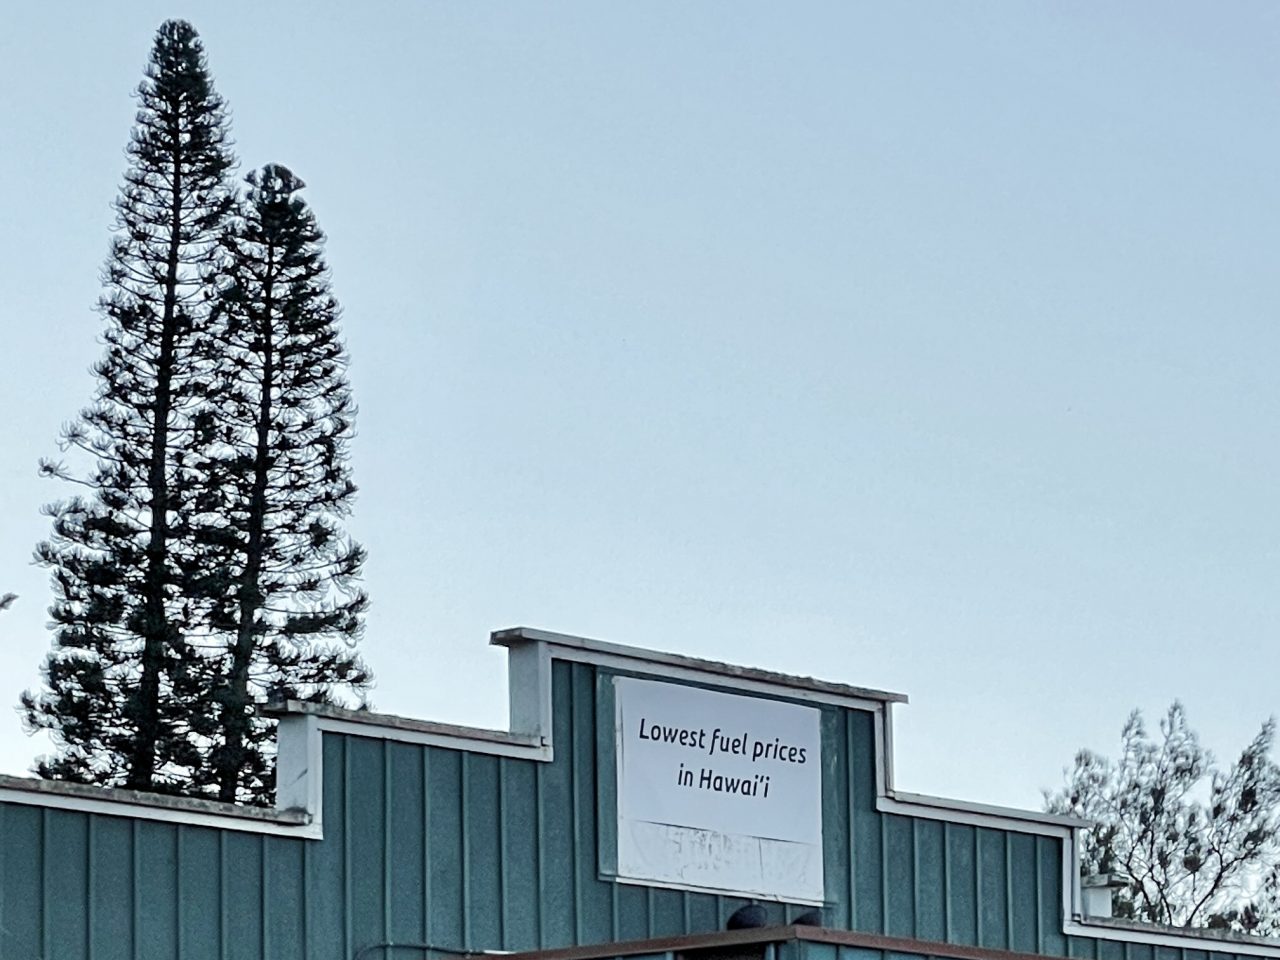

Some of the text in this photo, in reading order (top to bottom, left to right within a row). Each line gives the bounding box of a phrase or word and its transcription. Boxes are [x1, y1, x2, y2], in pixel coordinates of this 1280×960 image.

[639, 718, 807, 764] Lowest fuel prices
[677, 763, 693, 787] in
